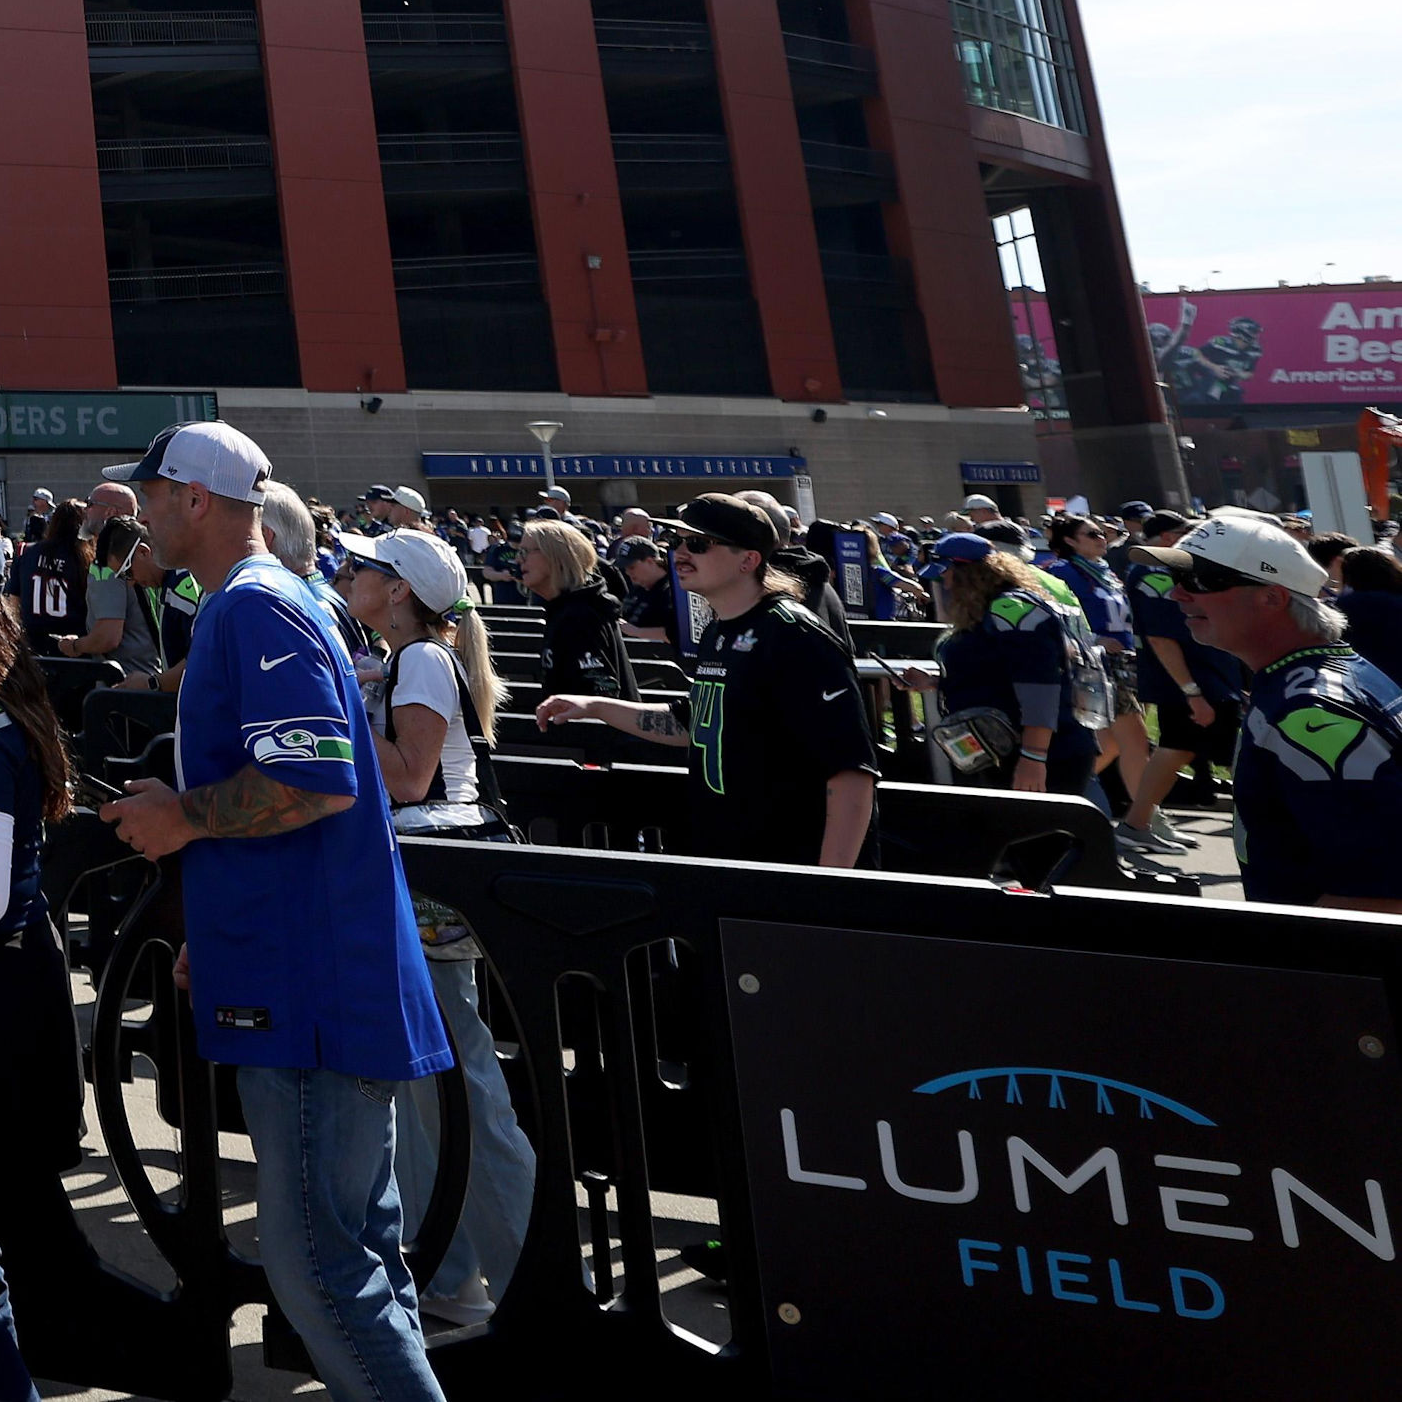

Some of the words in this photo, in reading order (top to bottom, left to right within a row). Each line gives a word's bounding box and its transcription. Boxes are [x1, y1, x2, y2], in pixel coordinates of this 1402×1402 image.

[1271, 367, 1396, 383] America's
[76, 406, 120, 436] FC
[470, 460, 596, 475] NORTHEST
[613, 460, 687, 475] TICKET
[703, 461, 774, 475] OFFICE
[31, 574, 69, 618] 10
[779, 1107, 1396, 1263] LUMEN
[957, 1238, 1227, 1321] FIELD
